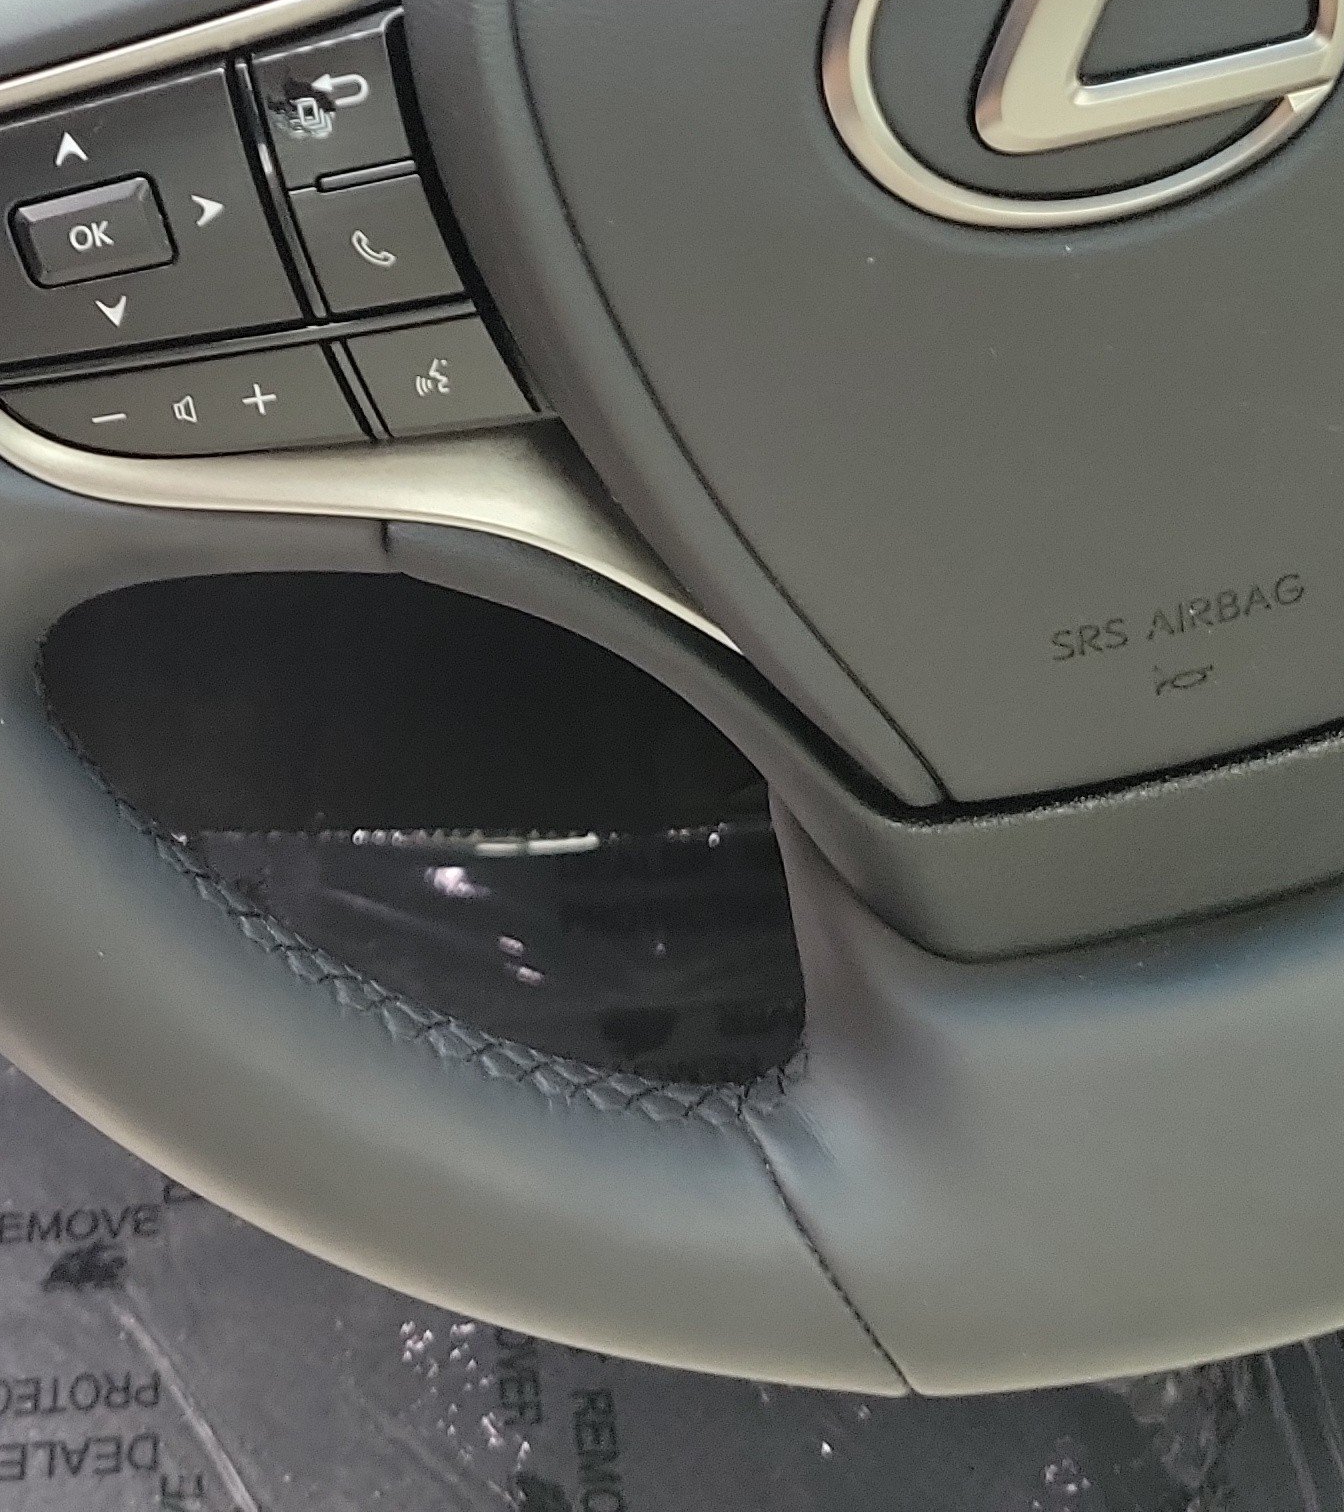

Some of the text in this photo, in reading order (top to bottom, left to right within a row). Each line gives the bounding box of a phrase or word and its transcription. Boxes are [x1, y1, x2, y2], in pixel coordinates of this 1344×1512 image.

[68, 219, 115, 253] OK
[1051, 572, 1306, 662] SRS AIRBAG
